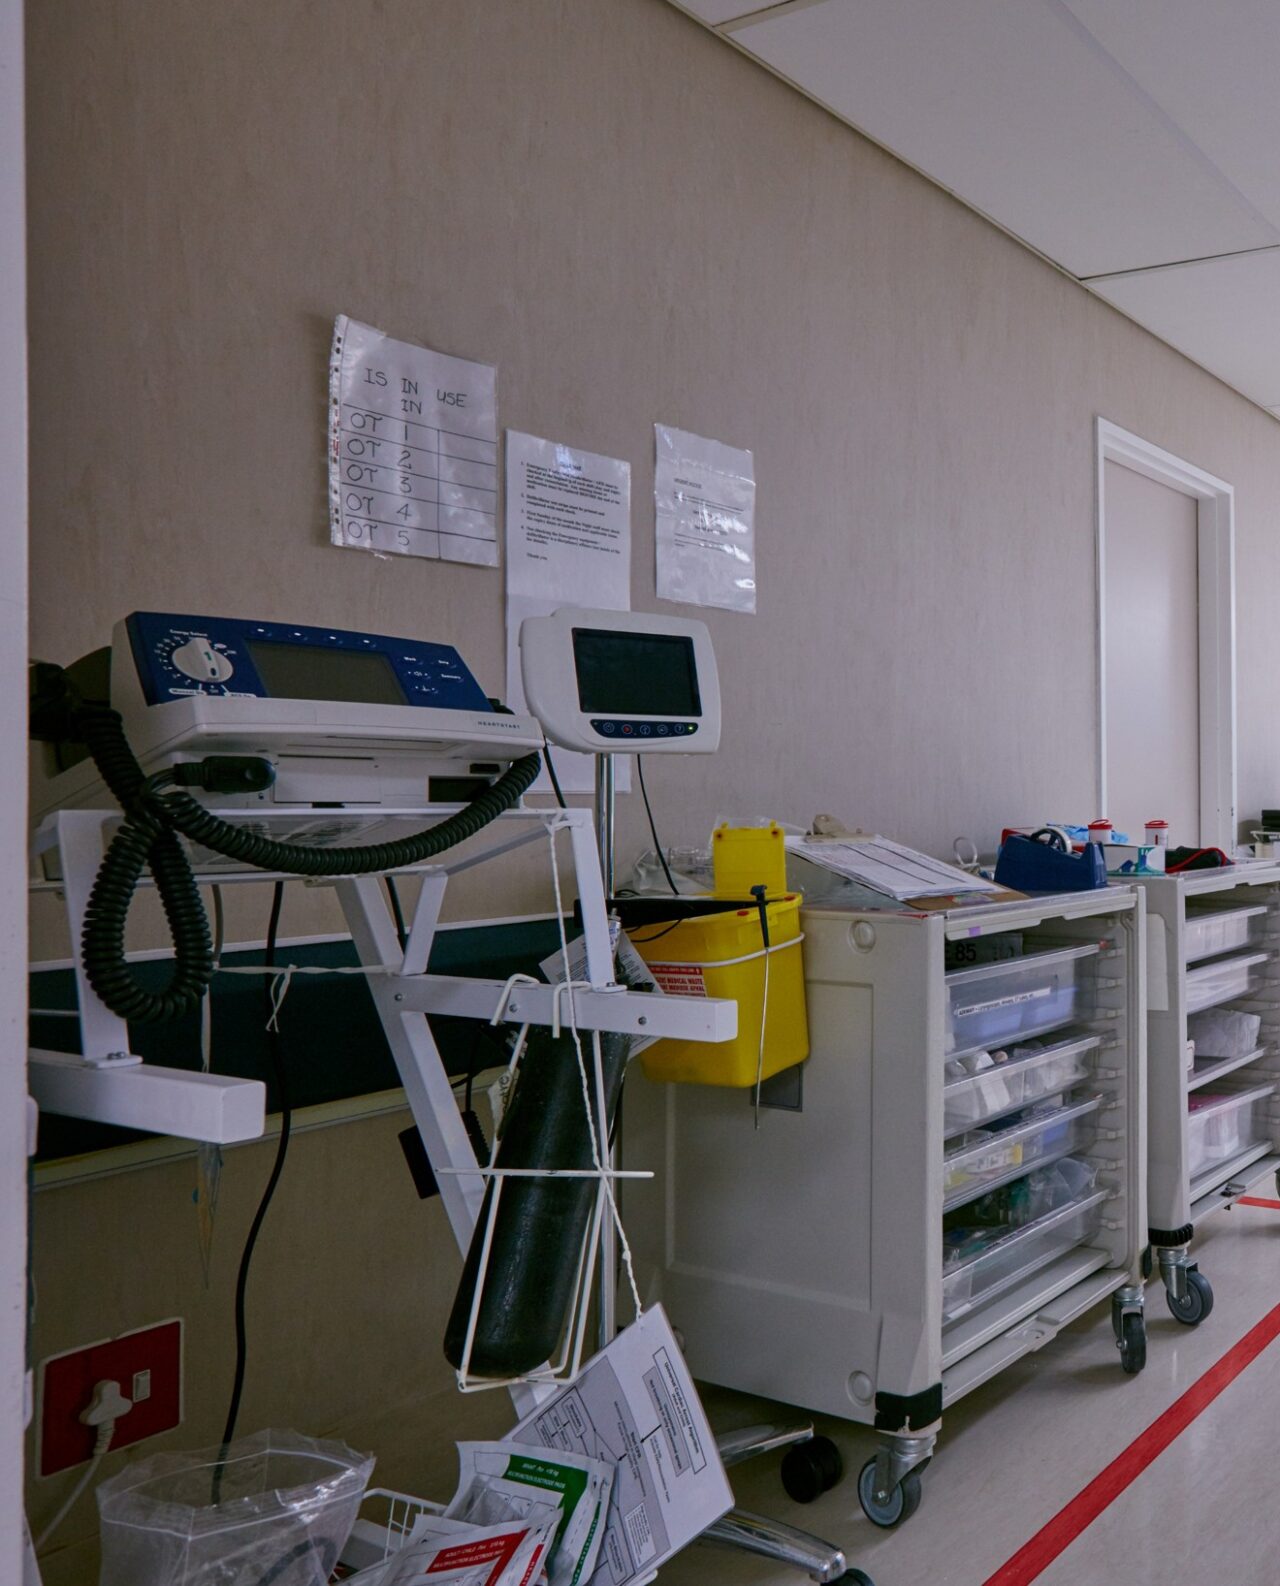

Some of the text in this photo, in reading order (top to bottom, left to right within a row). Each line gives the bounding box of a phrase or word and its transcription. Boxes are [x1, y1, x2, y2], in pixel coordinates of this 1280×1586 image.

[364, 368, 467, 408] IS IN USE
[401, 399, 422, 415] IN
[350, 412, 409, 441] OT 1
[347, 438, 412, 470] OT 2
[346, 464, 412, 494] OT 3
[346, 492, 412, 521] OT 4
[347, 520, 410, 546] OT 5
